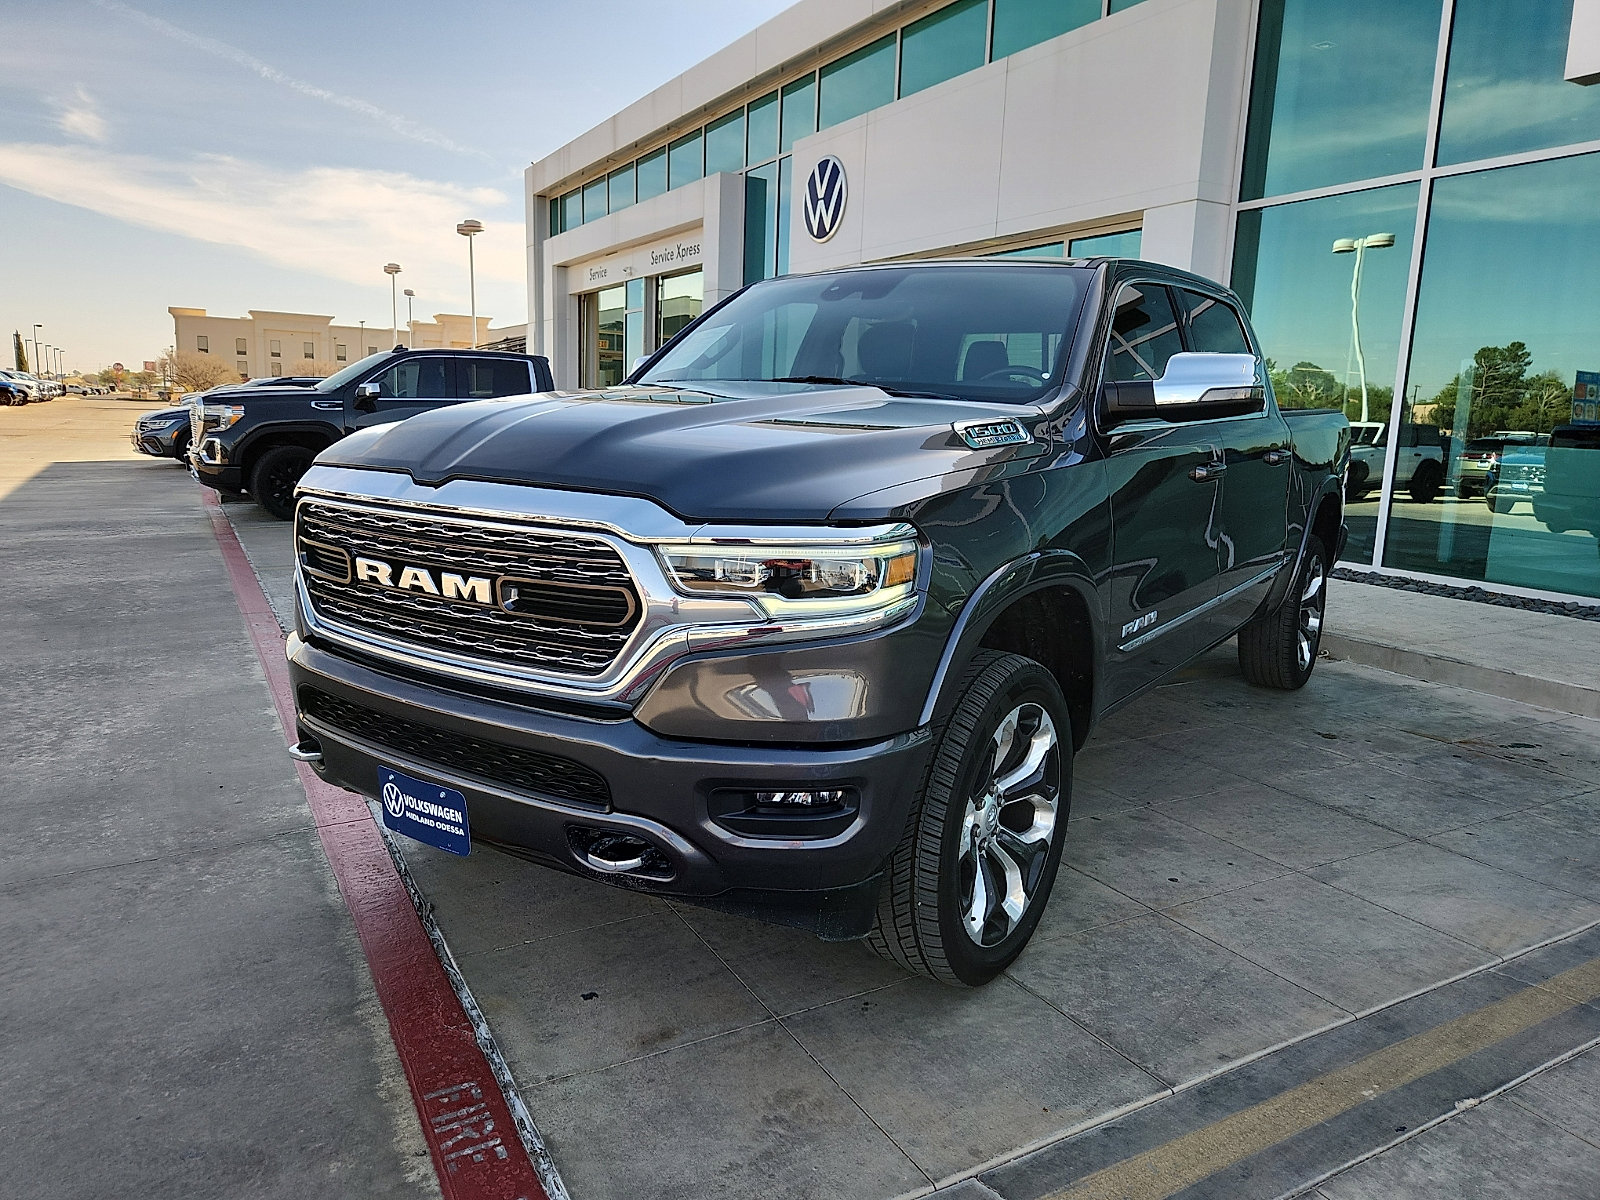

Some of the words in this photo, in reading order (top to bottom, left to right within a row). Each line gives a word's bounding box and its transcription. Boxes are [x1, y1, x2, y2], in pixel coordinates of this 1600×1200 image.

[650, 249, 675, 266] Service
[676, 242, 701, 261] Xpress
[589, 266, 607, 281] Service
[969, 423, 1016, 438] 1500
[355, 556, 492, 604] RAM
[1121, 610, 1158, 638] RAM
[403, 793, 463, 824] VOLKSWAGEN
[405, 810, 435, 828] MIDLAND
[435, 821, 465, 836] ODESSA
[424, 1080, 508, 1173] FIRE
